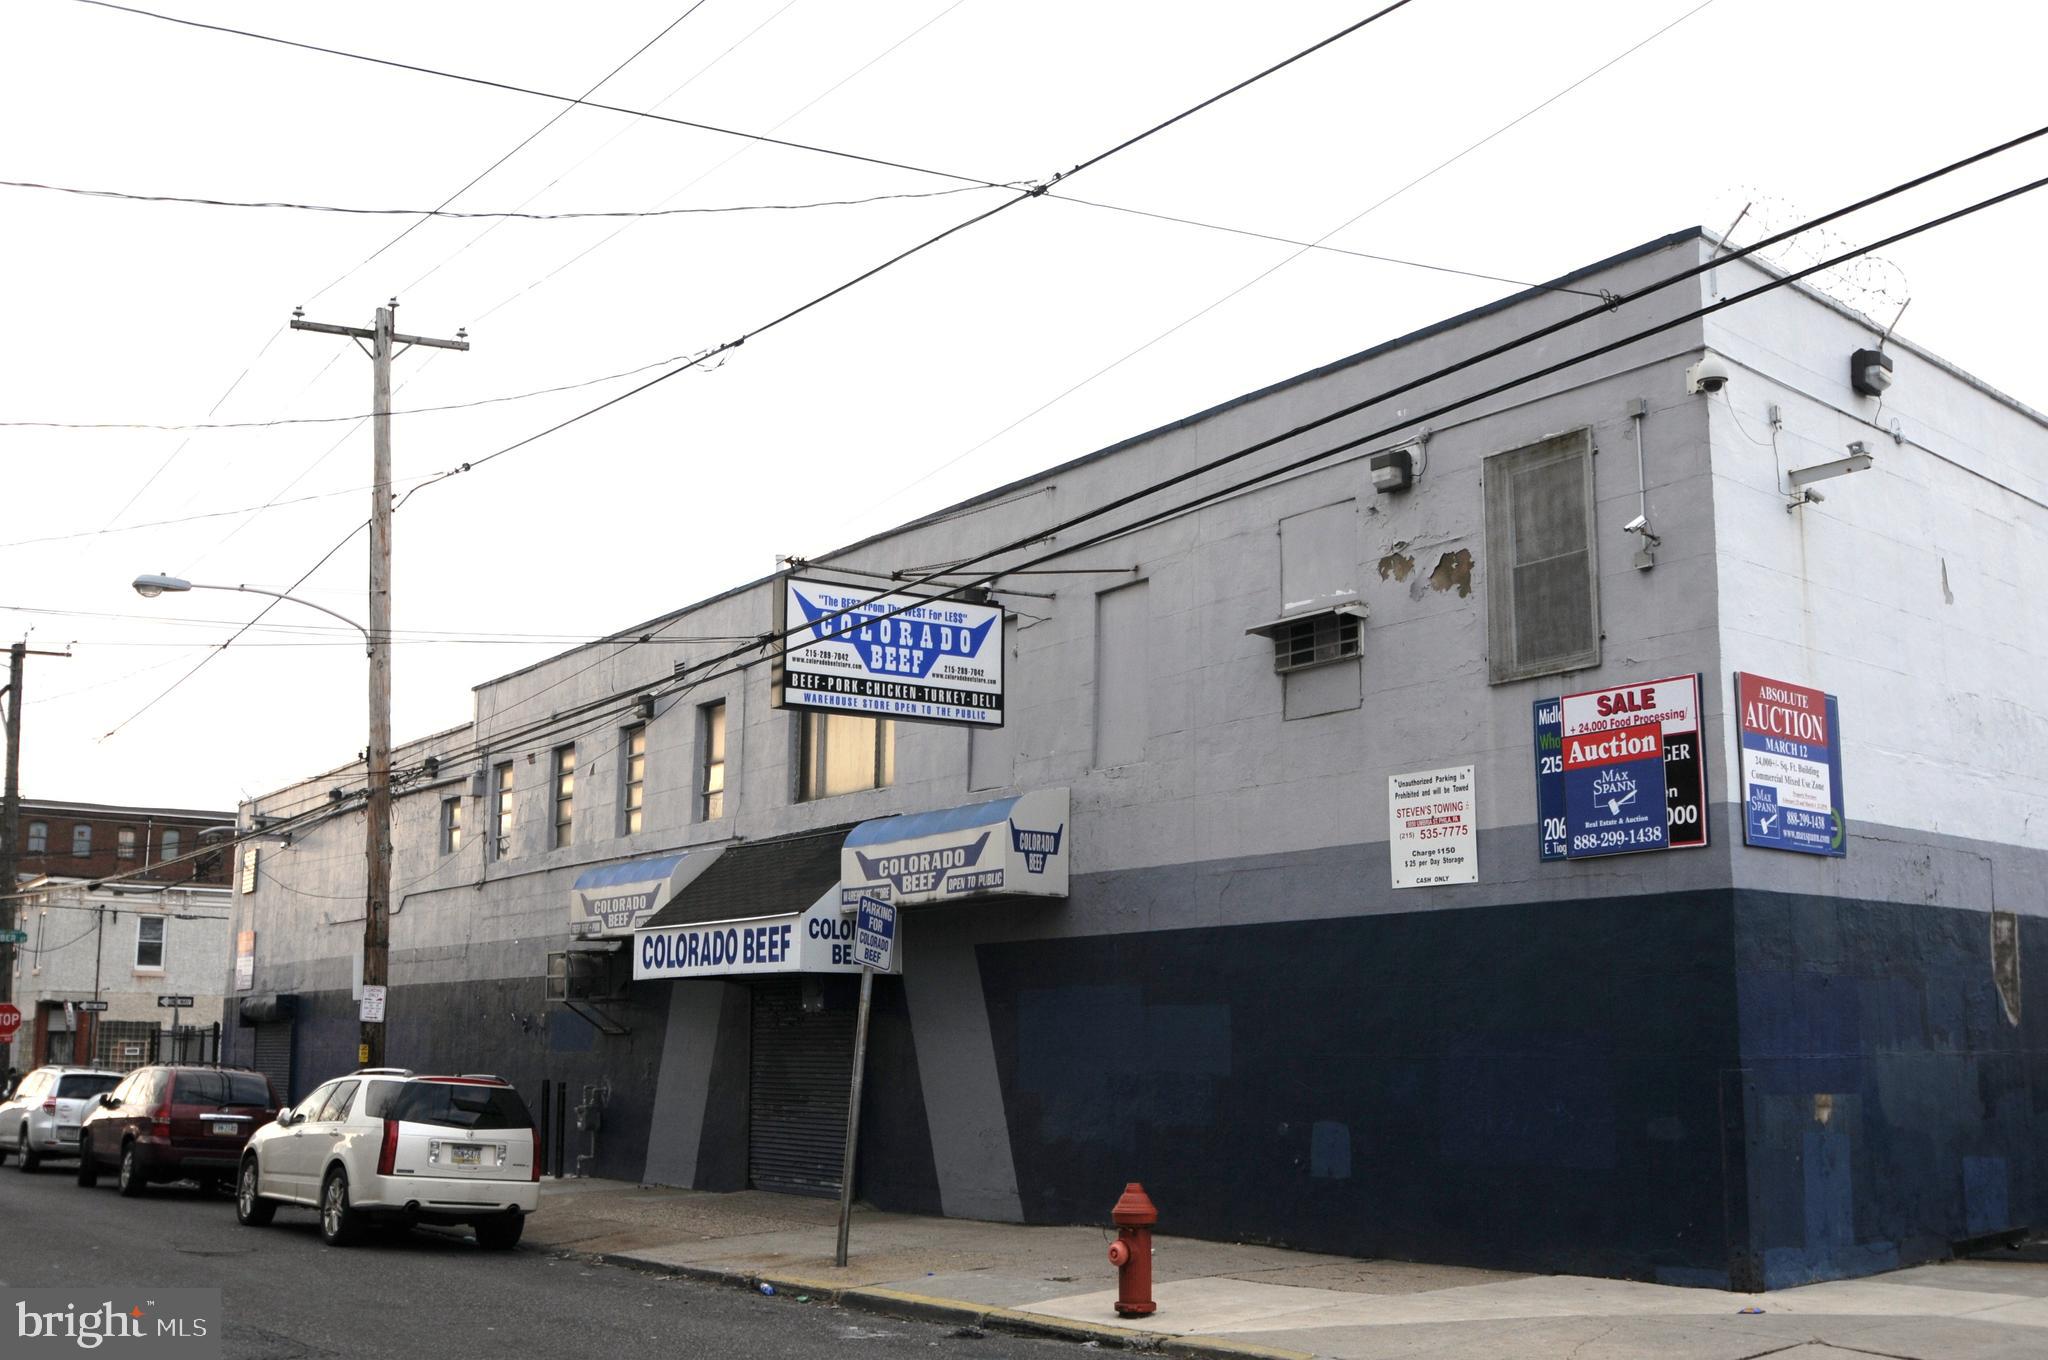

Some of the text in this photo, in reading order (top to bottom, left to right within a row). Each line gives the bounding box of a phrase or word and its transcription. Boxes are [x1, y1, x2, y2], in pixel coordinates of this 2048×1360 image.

[929, 610, 942, 620] For
[821, 612, 971, 653] COLORADO
[805, 649, 849, 661] 215-289-7042
[870, 645, 924, 673] BEEF
[944, 665, 985, 677] 215-289-7042
[804, 692, 986, 720] WAREHOUSE STORE OPEN TO THE PUBLIC
[1597, 688, 1657, 717] SALE
[1759, 685, 1809, 709] ABSOLUTE
[1610, 716, 1631, 728] Food
[1745, 700, 1824, 741] AUCTION
[1568, 732, 1657, 764] Auction
[1765, 737, 1808, 758] MARCH 12
[1751, 770, 1825, 791] Commercial Mixed Use Zone
[1798, 764, 1820, 778] Building
[1398, 777, 1433, 788] Unauthorized
[1435, 774, 1457, 784] Parking
[1395, 784, 1469, 800] Prohibited and will be Towed
[1396, 805, 1432, 818] STEVEN'S
[1433, 801, 1463, 814] TOWING
[1585, 815, 1649, 829] Real Estate & Auction
[1786, 811, 1825, 830] 888-299-1438
[1399, 825, 1468, 840] (215) 535-7775
[1573, 826, 1662, 850] 888-299-1438
[1782, 829, 1831, 844] www.maxspann.com
[1019, 832, 1054, 853] COLORADO
[1412, 847, 1456, 857] Charge $150
[879, 849, 965, 877] COLORADO
[1029, 854, 1043, 871] BEEF
[1419, 859, 1427, 868] per
[1430, 857, 1440, 866] Day
[1443, 856, 1464, 865] Storage
[902, 872, 936, 893] BEEF
[948, 871, 1003, 891] OPEN TO PUBLIC
[594, 895, 647, 914] COLORADO
[861, 901, 893, 922] PARKING
[608, 911, 629, 928] BEEF
[868, 917, 883, 933] FOR
[642, 924, 792, 969] COLORADO BEEF
[859, 930, 889, 952] COLORADO
[832, 943, 862, 965] BE
[864, 947, 881, 964] BEEF
